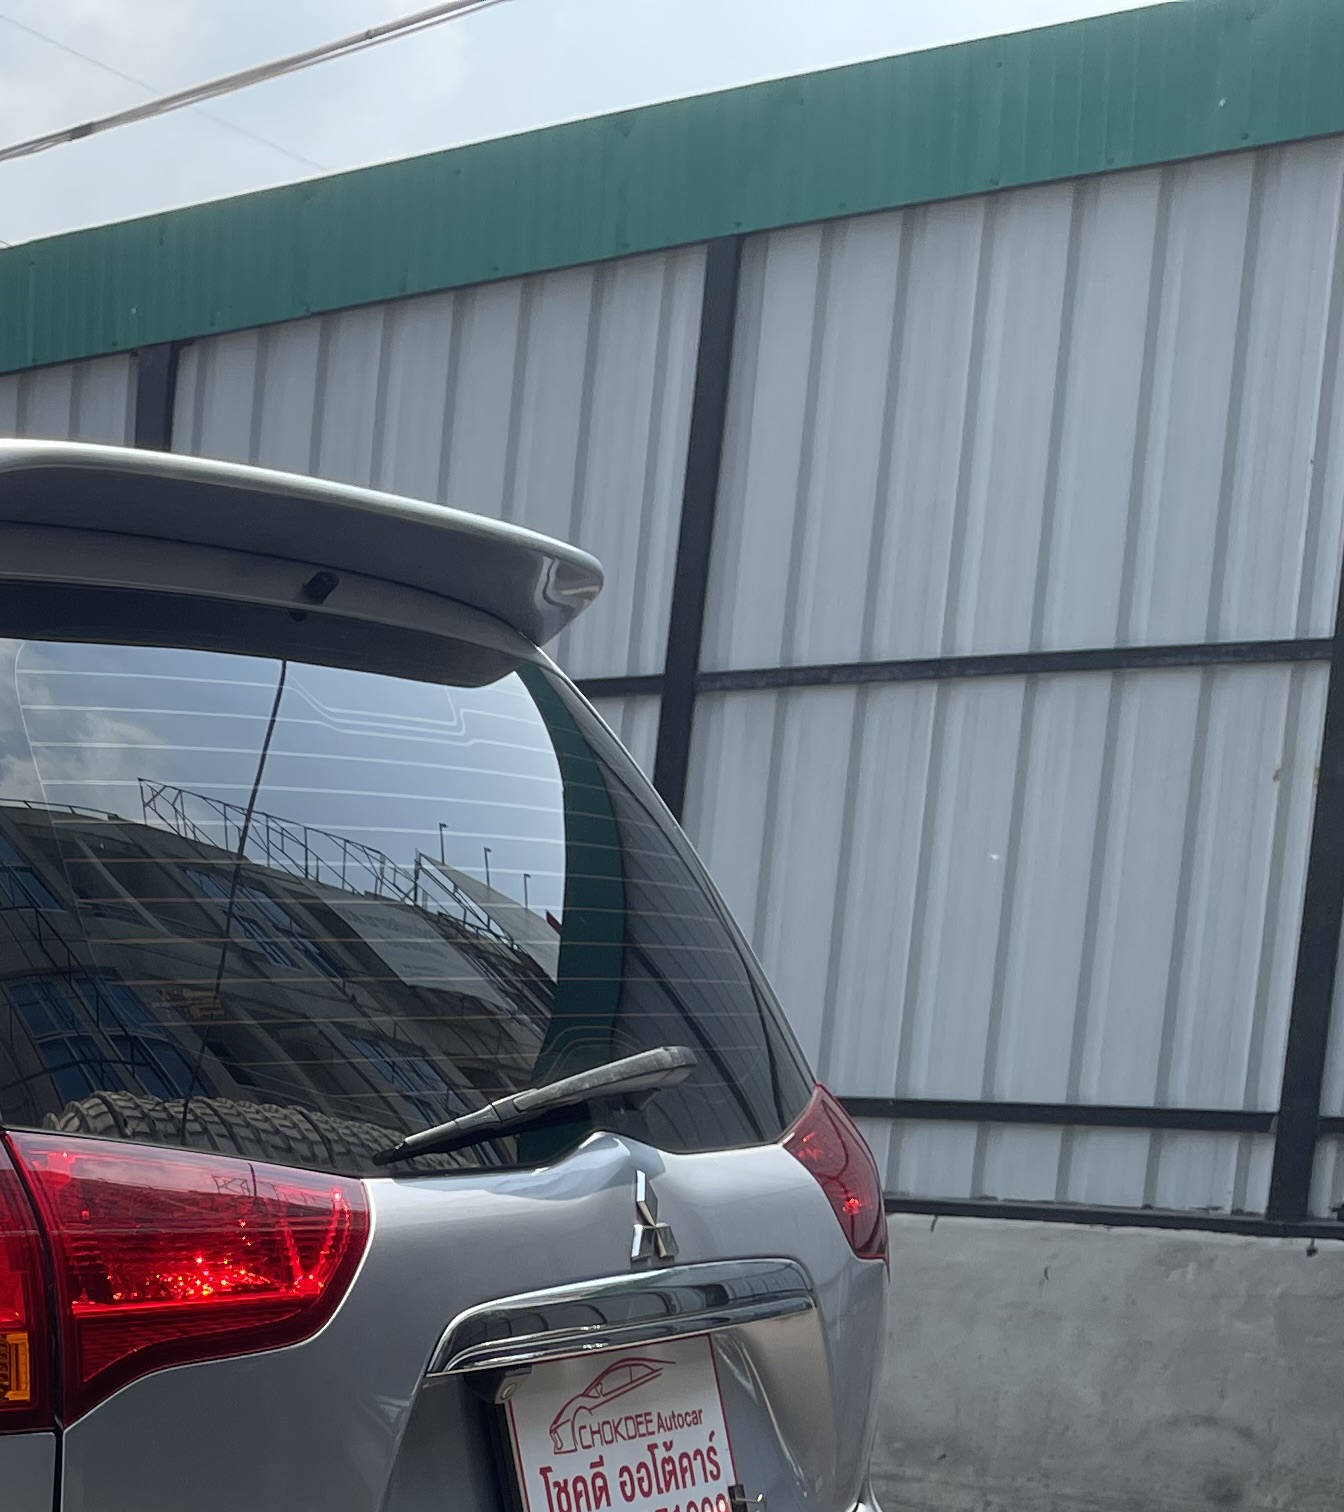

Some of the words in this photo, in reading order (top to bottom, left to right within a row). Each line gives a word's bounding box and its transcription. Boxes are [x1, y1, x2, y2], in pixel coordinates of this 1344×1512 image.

[578, 1412, 655, 1450] CHOKDEE
[657, 1408, 703, 1434] Autocar
[618, 1430, 721, 1502] ออโต้คาร์
